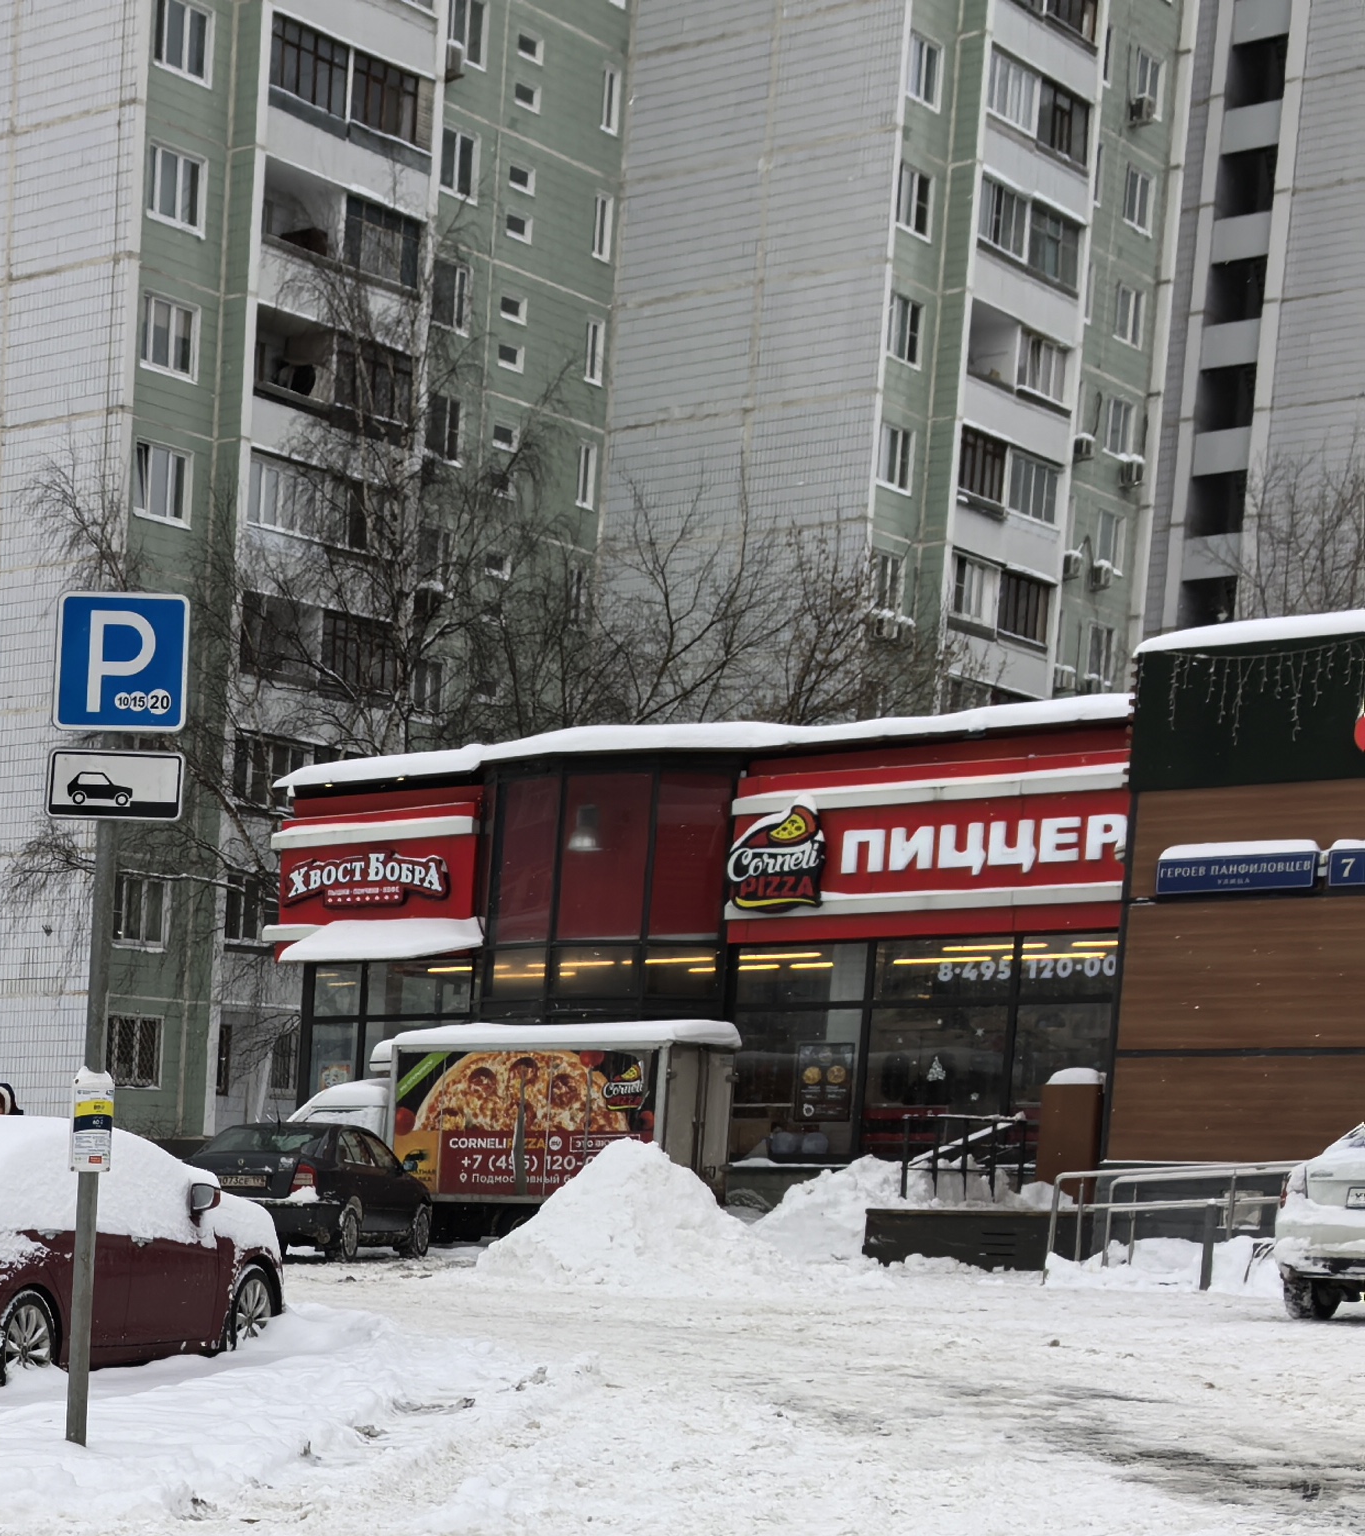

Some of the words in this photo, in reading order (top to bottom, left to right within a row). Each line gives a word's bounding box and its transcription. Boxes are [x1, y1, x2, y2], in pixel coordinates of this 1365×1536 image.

[86, 609, 156, 712] P
[130, 695, 146, 707] 15
[150, 694, 170, 709] 20
[727, 840, 820, 882] Corneli
[1160, 865, 1206, 879] ГЕРОЕВ
[1210, 859, 1311, 876] ПАНФИЛОВЦЕВ
[1340, 857, 1356, 878] 7
[740, 876, 814, 897] PIZZA
[461, 1155, 483, 1169] +7
